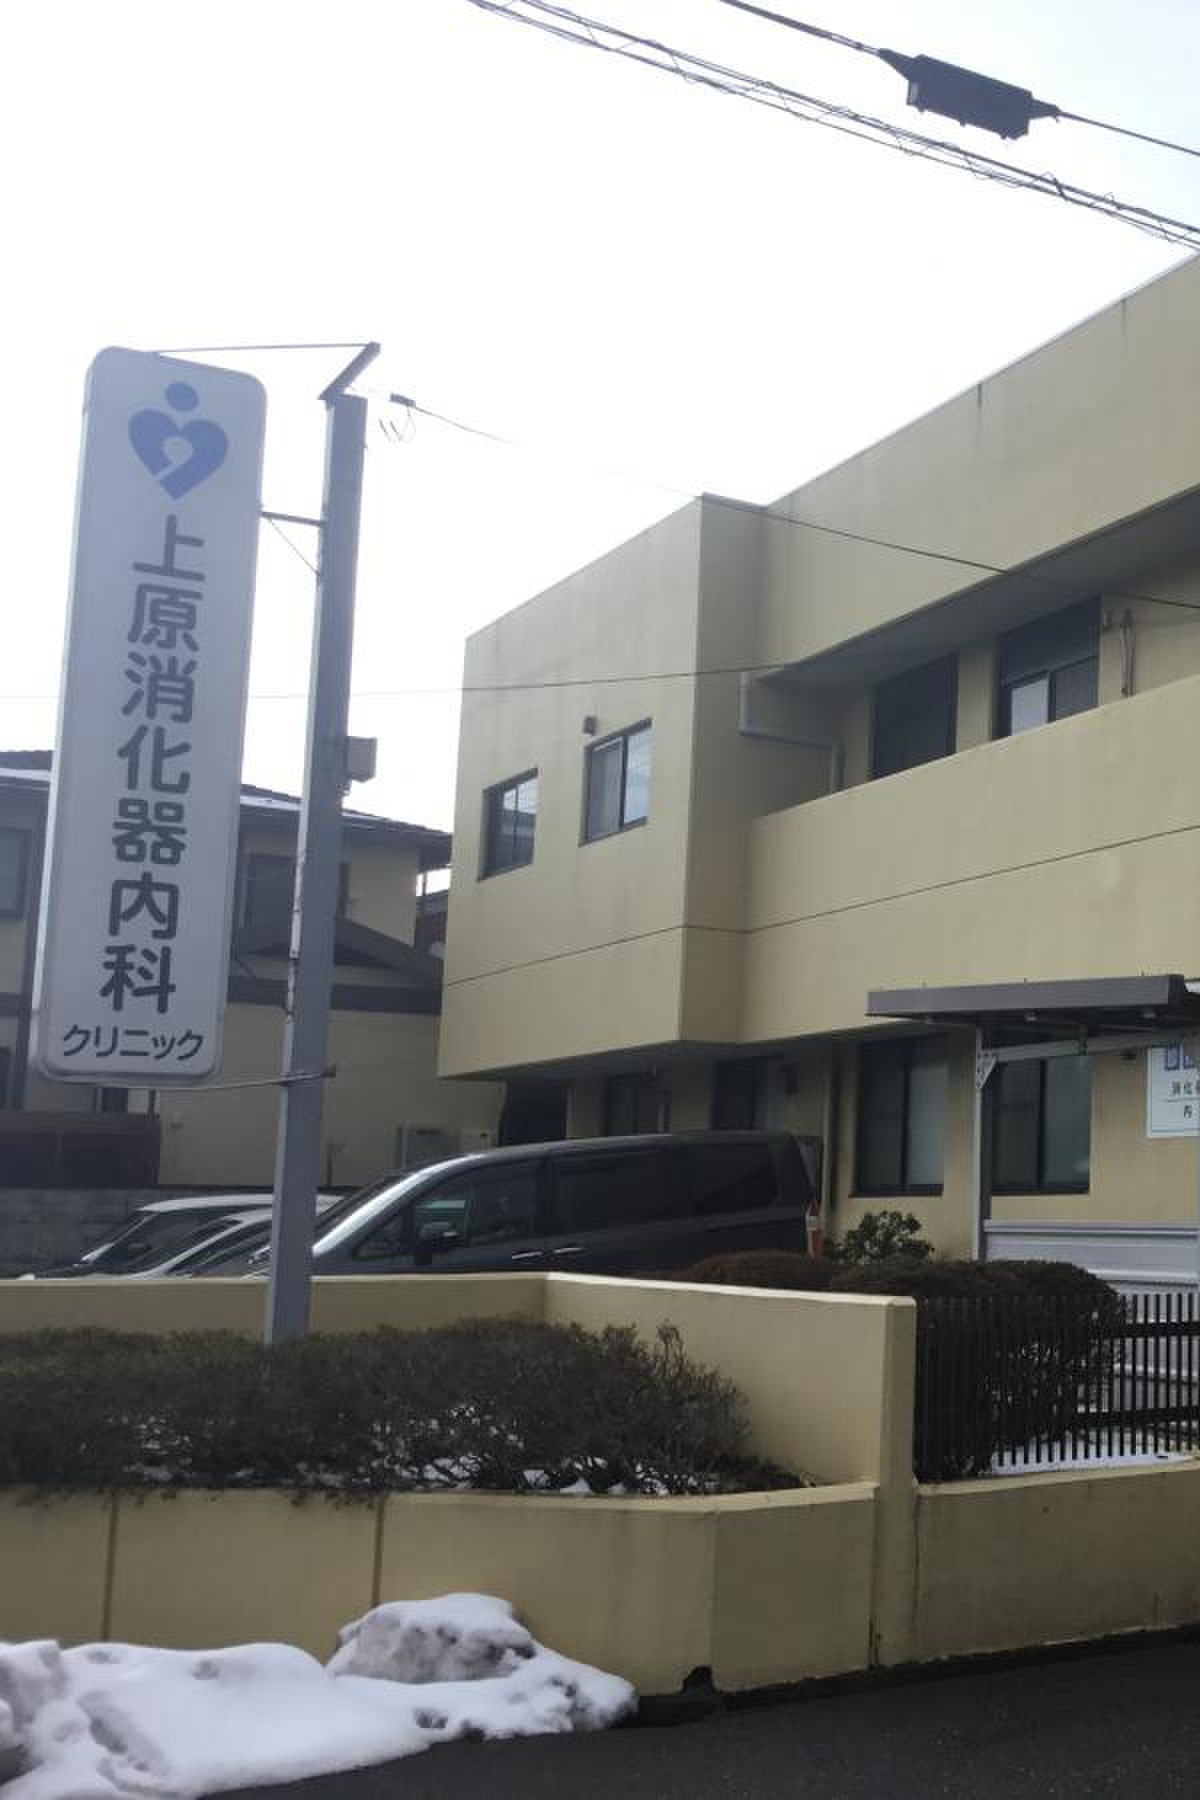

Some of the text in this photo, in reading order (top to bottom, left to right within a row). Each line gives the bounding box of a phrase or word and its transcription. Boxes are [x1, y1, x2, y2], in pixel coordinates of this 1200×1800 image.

[100, 514, 205, 1014] 上原消化器内科
[63, 1024, 204, 1061] クリニック
